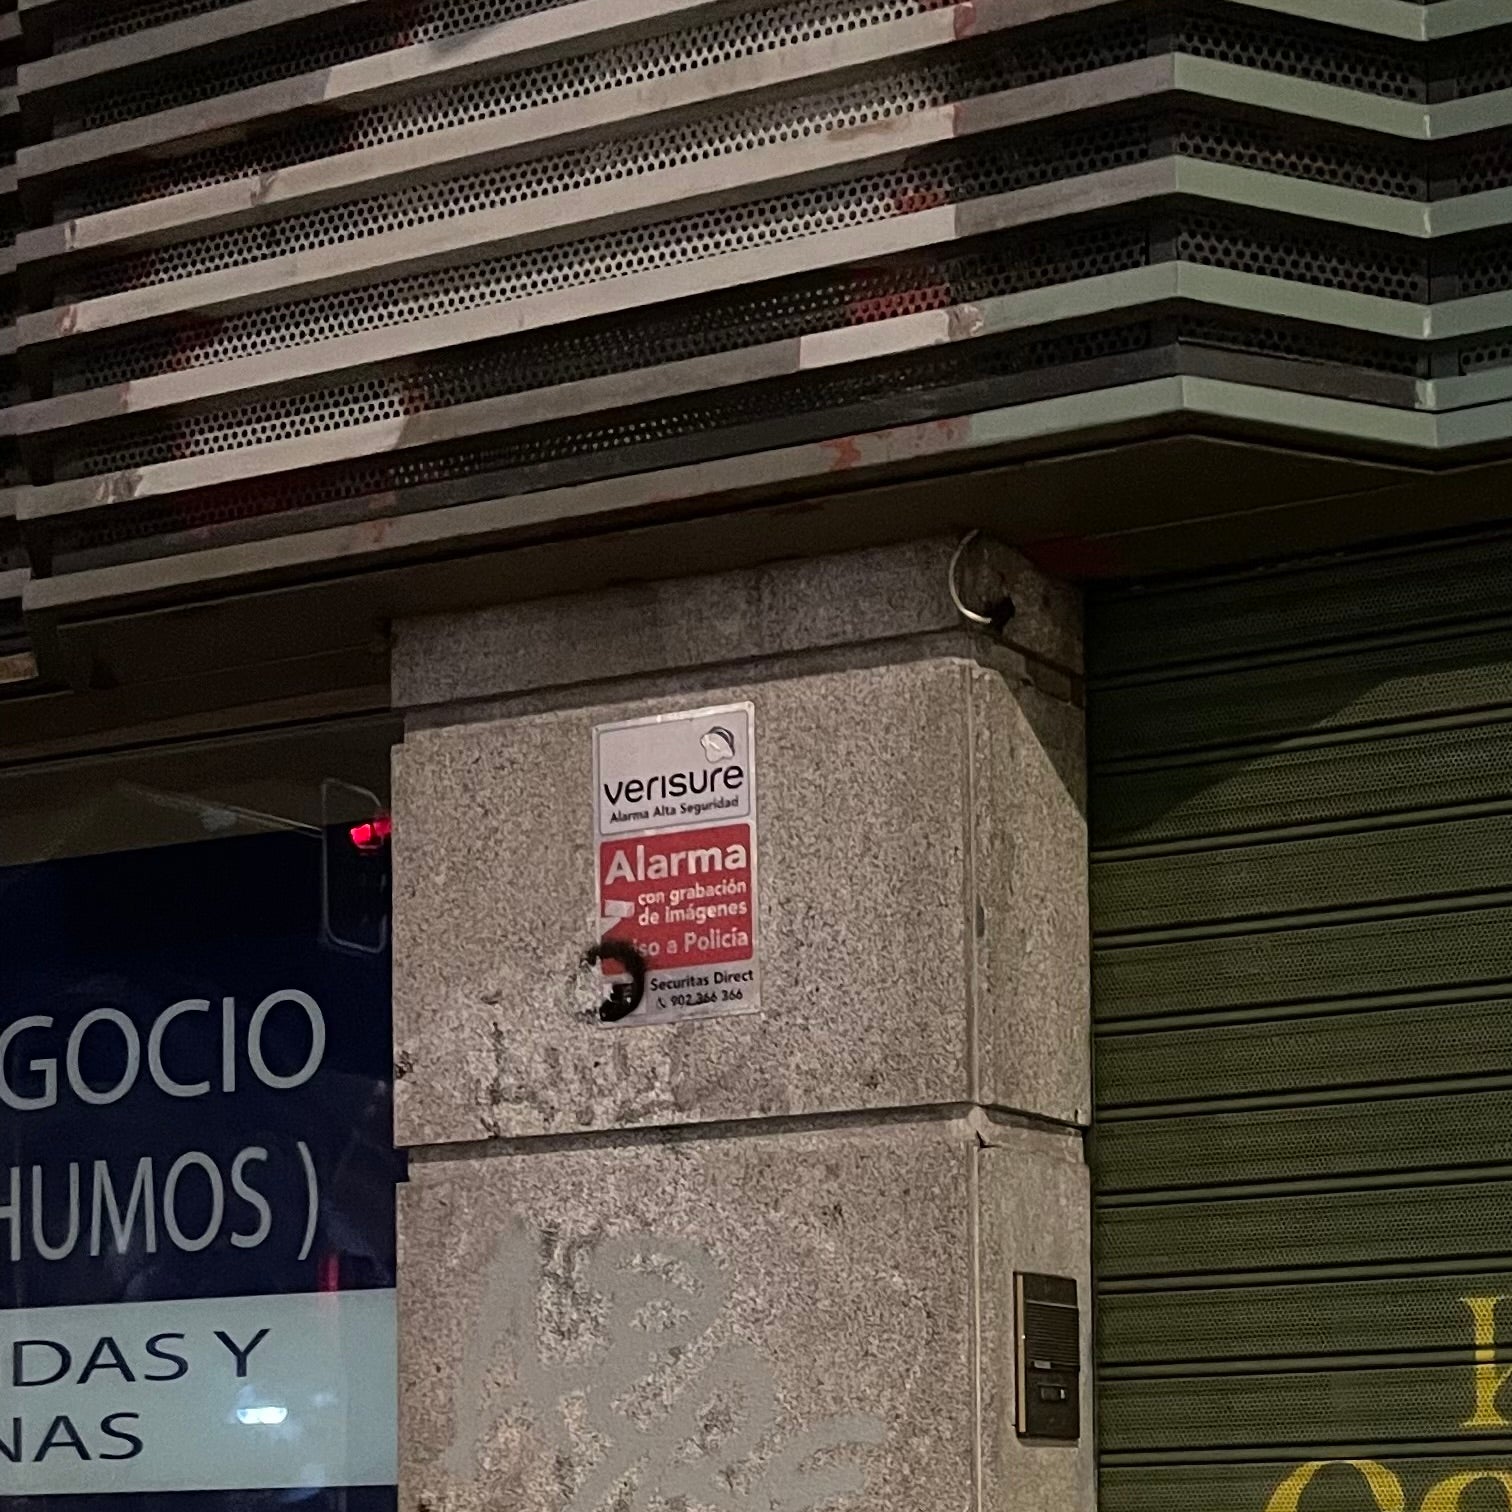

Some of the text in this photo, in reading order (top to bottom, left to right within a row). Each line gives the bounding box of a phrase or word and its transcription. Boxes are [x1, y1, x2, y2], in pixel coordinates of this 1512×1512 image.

[603, 765, 744, 806] verisure
[609, 795, 739, 824] Alarma Alta Seguridad
[604, 843, 747, 885] Alarma
[638, 879, 747, 906] con grabación
[638, 901, 747, 926] de imágenes
[666, 939, 678, 954] a
[684, 927, 748, 953] Policía
[650, 969, 753, 991] Securitas Direct
[721, 988, 743, 1001] 366
[0, 989, 326, 1111] GOCIO
[12, 1328, 271, 1387] DAS Y
